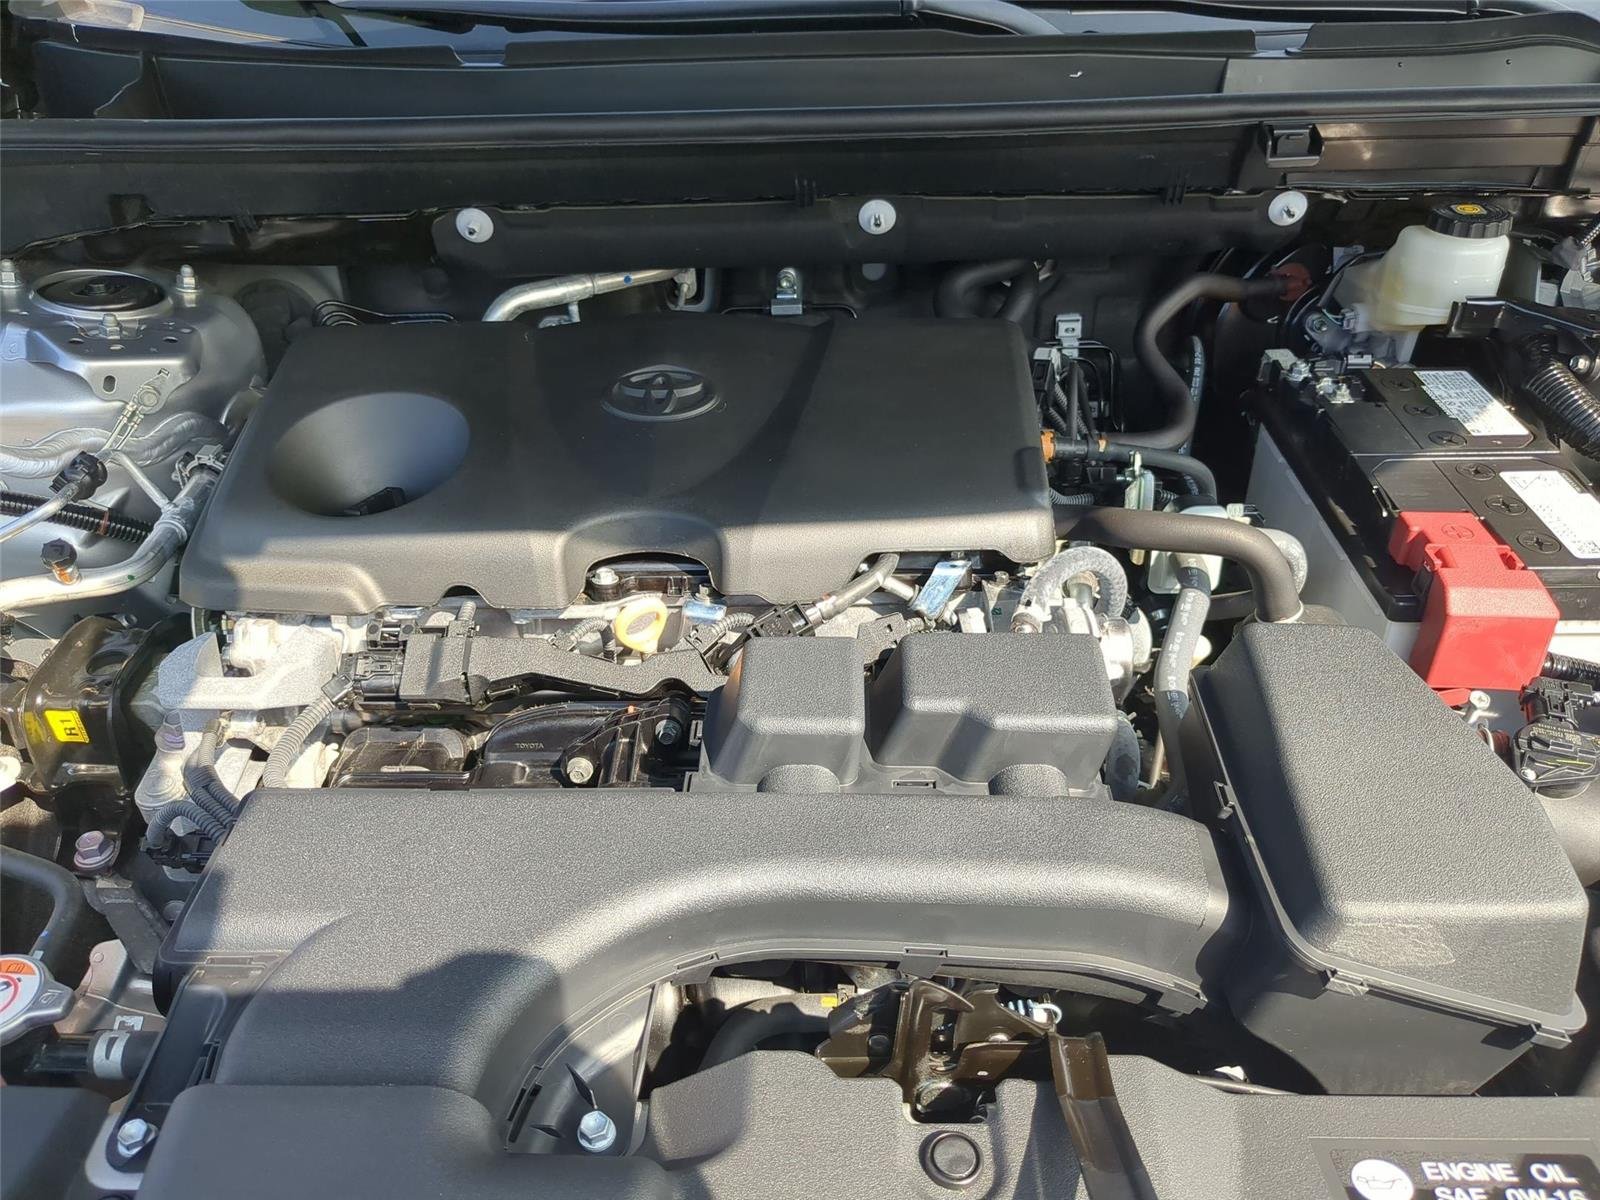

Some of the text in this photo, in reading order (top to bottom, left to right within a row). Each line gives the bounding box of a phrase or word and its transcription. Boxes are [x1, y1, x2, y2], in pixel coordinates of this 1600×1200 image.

[1420, 1161, 1580, 1185] ENGINE OIL
[1433, 1186, 1489, 1200] SAE
